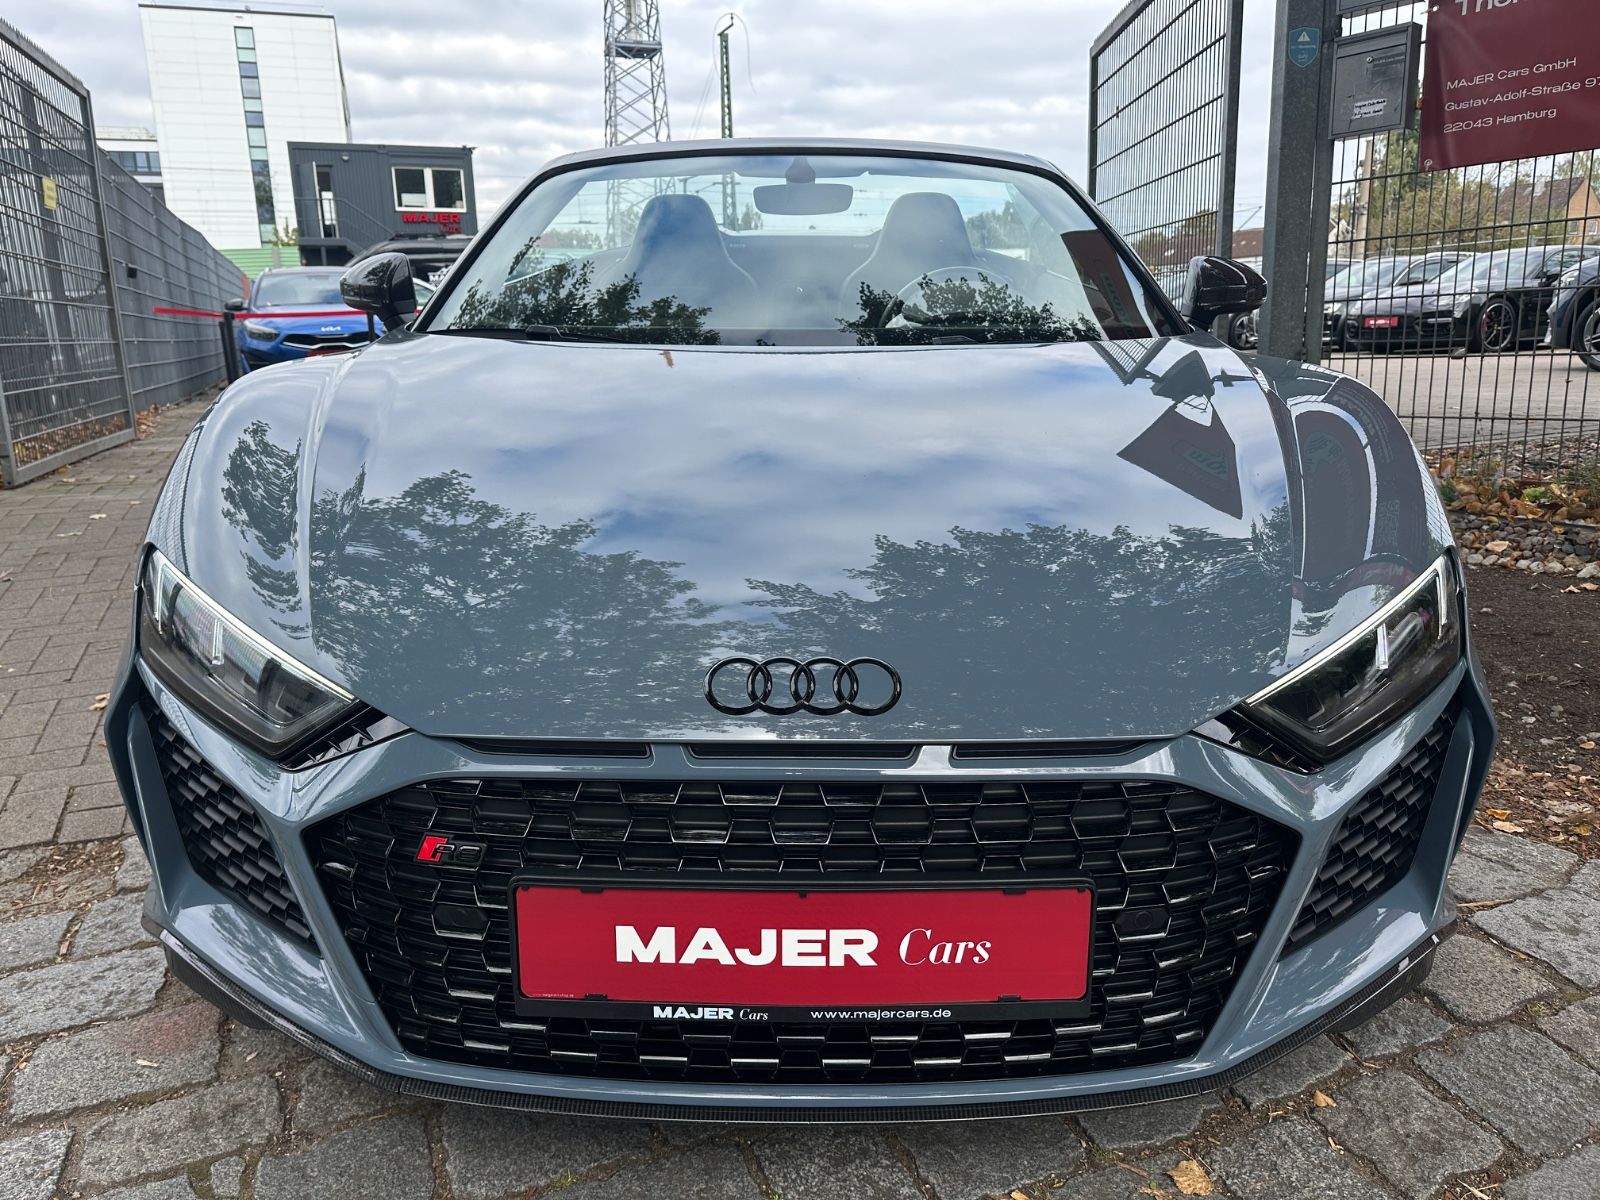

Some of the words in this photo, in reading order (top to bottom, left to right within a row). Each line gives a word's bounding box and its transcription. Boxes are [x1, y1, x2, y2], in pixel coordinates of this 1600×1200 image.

[1446, 73, 1495, 90] MAJER
[1497, 67, 1530, 80] Cars
[1533, 57, 1578, 73] GmbH
[1444, 81, 1581, 111] Gustav-Adolf-Straße
[1442, 117, 1493, 133] 22043
[1496, 108, 1557, 125] Hamburg
[402, 212, 461, 224] MAJER
[615, 925, 879, 967] MAJER
[899, 928, 992, 966] Cars
[653, 1006, 734, 1020] MAJER
[740, 1006, 769, 1020] Cars
[810, 1009, 952, 1022] www.majercars.de
